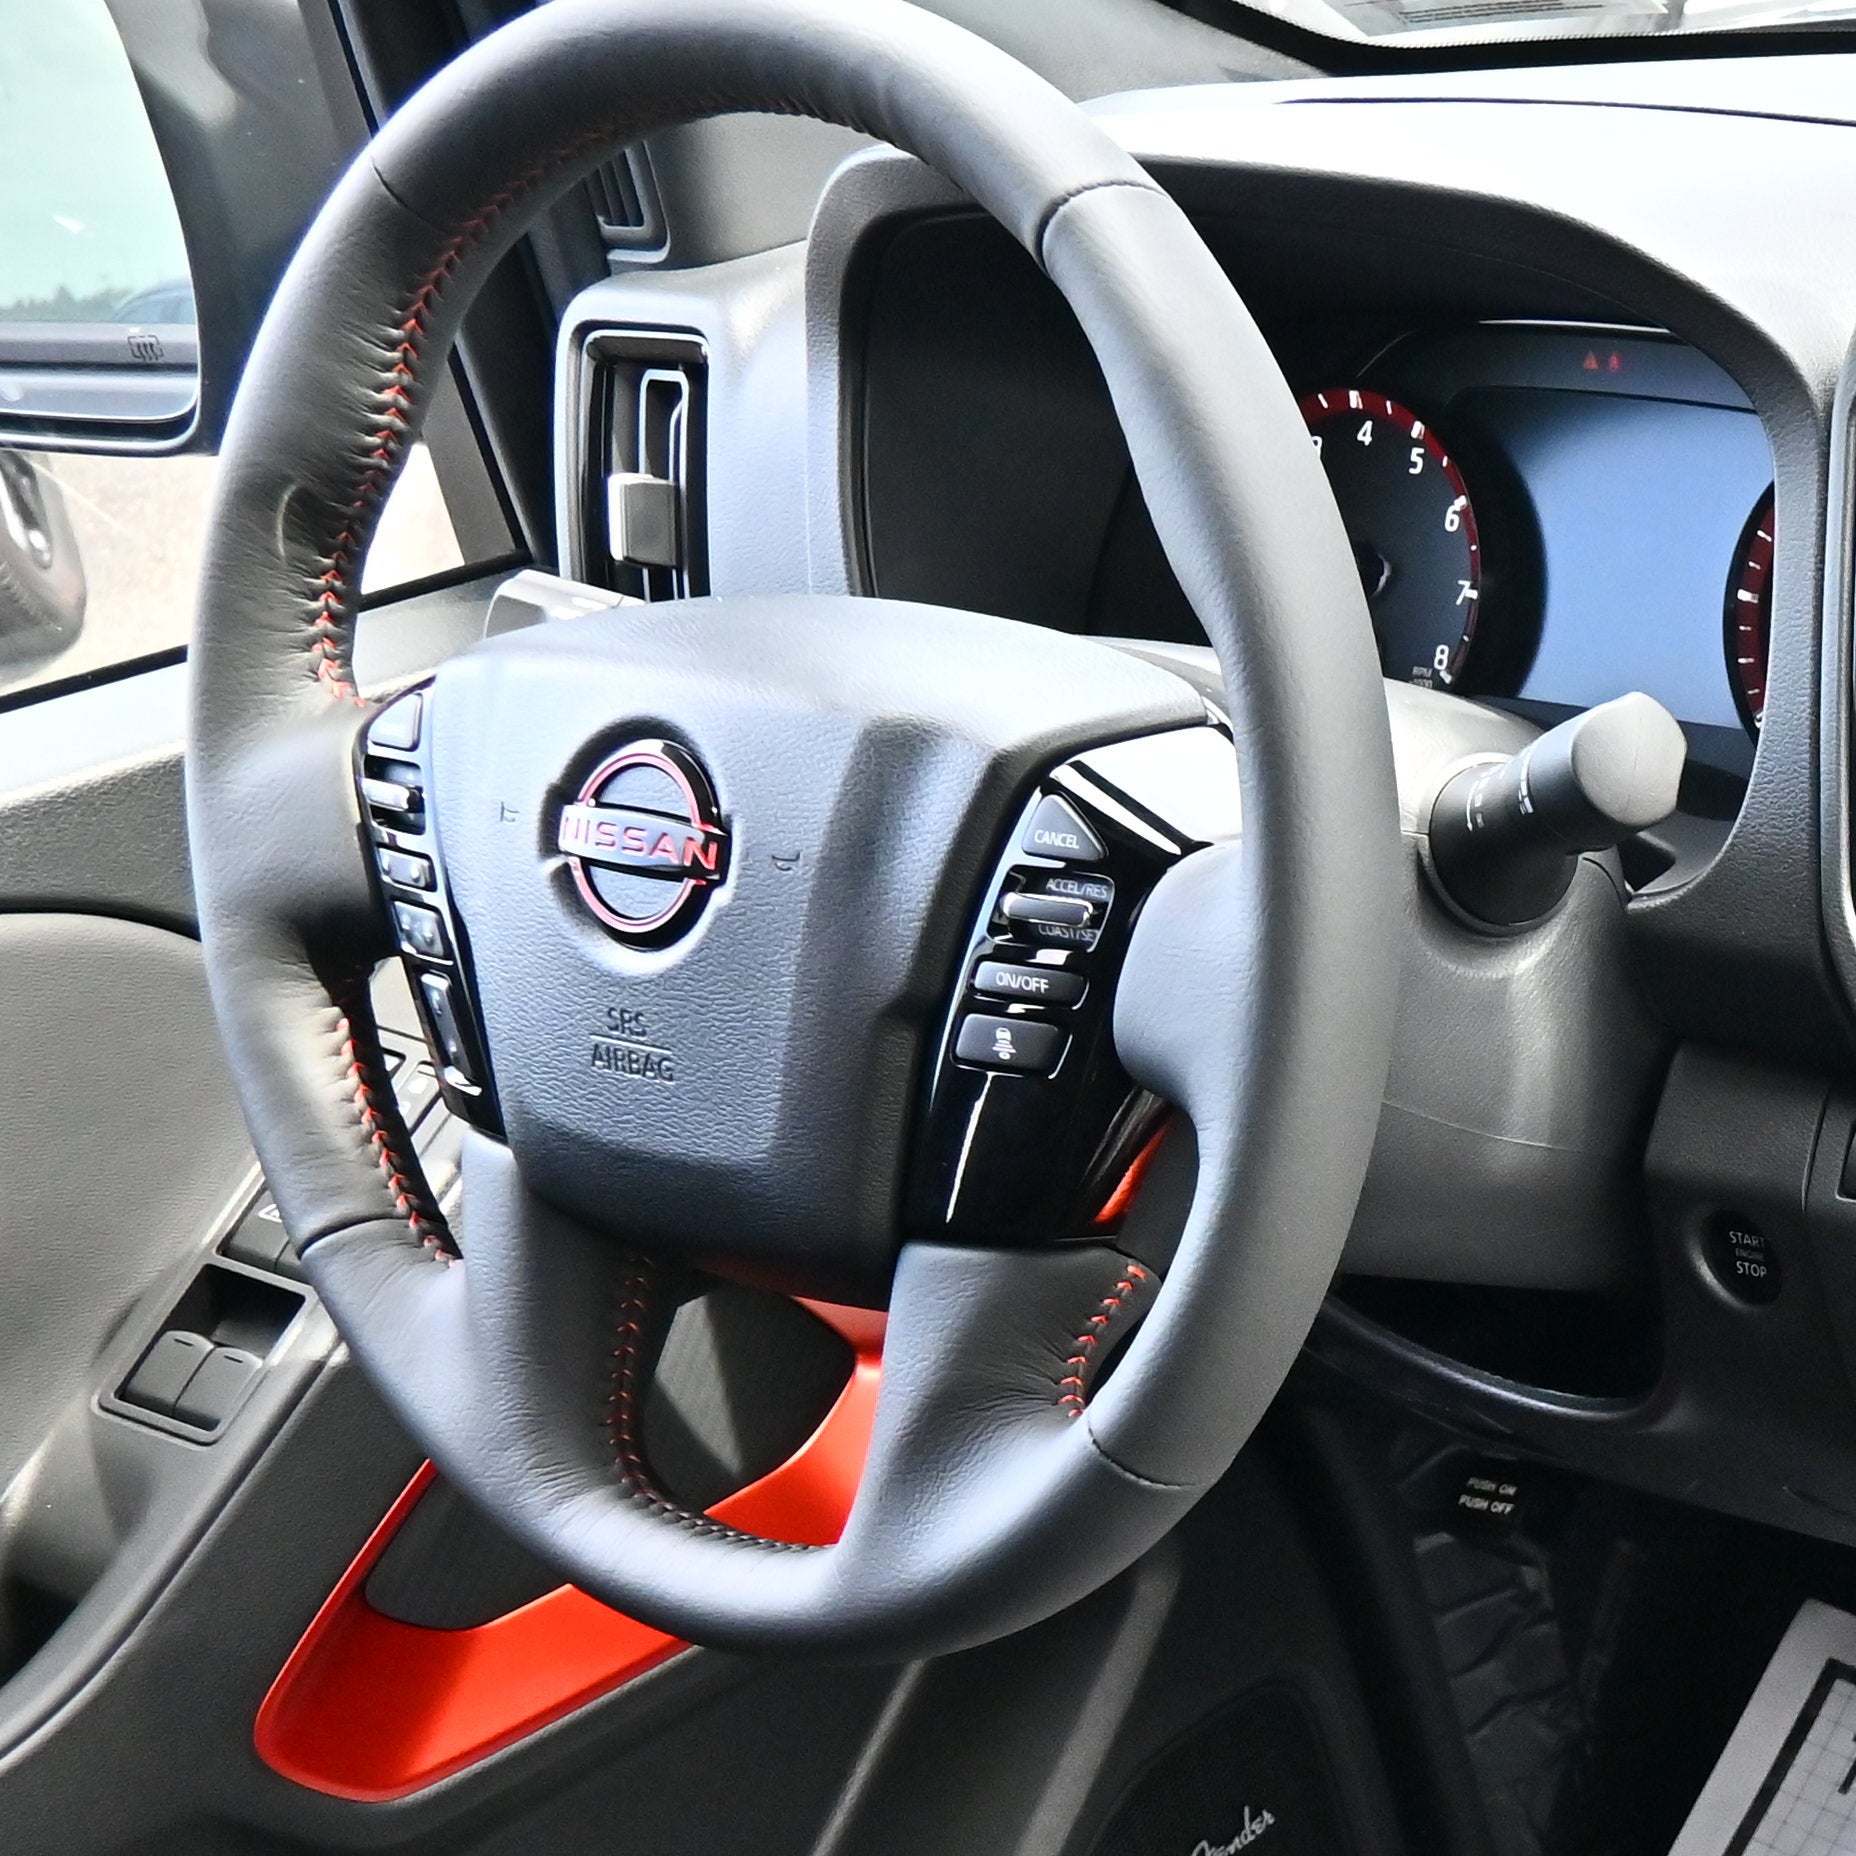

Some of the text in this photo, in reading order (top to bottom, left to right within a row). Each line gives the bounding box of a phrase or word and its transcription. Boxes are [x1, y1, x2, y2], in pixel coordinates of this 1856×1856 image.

[1357, 420, 1374, 447] 4
[1409, 448, 1424, 475] 5
[1444, 503, 1460, 533] 6
[1456, 580, 1470, 605] 7
[1434, 644, 1449, 670] 8
[561, 809, 718, 871] NISSAN
[1034, 829, 1080, 849] CANCEL
[1046, 878, 1108, 899] ACCEL/RES
[995, 970, 1050, 995] ON/OFF
[606, 1009, 648, 1038] SRS
[591, 1046, 675, 1084] AIRBAG
[1729, 1231, 1764, 1248] START
[1736, 1261, 1767, 1277] STOP
